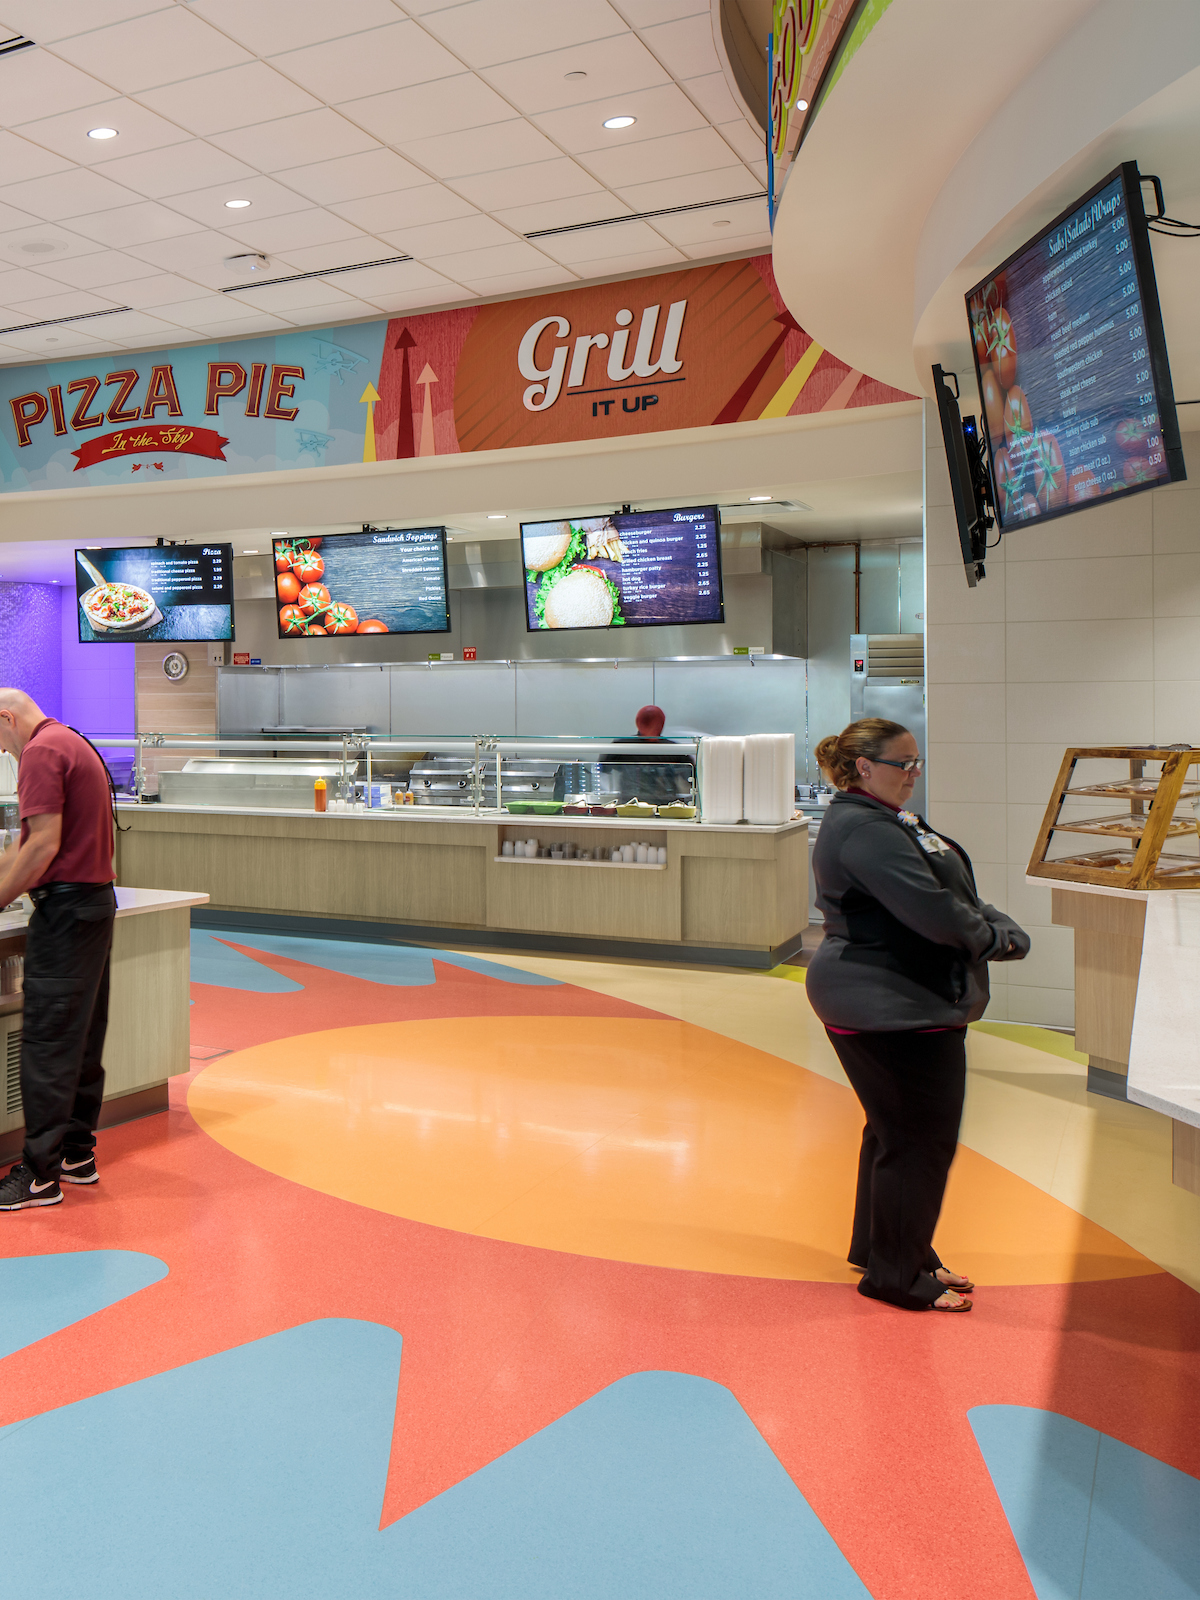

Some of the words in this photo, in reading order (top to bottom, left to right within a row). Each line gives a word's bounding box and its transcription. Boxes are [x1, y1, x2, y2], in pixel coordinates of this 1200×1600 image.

[1064, 247, 1082, 269] smoked
[1082, 235, 1098, 256] turkey
[1111, 215, 1125, 234] 5.00
[1044, 284, 1061, 304] chicken
[1060, 276, 1073, 293] salad
[1115, 236, 1128, 256] 5.00
[1118, 258, 1132, 277] 5.00
[1050, 327, 1061, 342] roast
[1061, 320, 1072, 335] beef
[1121, 280, 1135, 298] 5.00
[1053, 343, 1069, 362] roasted
[1069, 338, 1078, 352] red
[1077, 329, 1094, 348] pepper
[1125, 302, 1139, 320] 5.00
[518, 299, 688, 412] Grill
[1084, 347, 1102, 365] chicken
[1128, 324, 1142, 342] 5.00
[1070, 381, 1080, 393] and
[1080, 373, 1096, 389] cheese
[1132, 346, 1146, 363] 5.00
[9, 364, 183, 447] PIZZA
[203, 362, 305, 421] PIE
[592, 400, 615, 417] IT
[622, 395, 659, 413] UP
[1062, 404, 1077, 420] turkey
[1135, 368, 1149, 385] 5.00
[1065, 424, 1080, 438] turkey
[1079, 419, 1090, 432] club
[1089, 415, 1098, 428] sub
[1138, 390, 1152, 406] 5.00
[101, 433, 127, 454] In
[129, 432, 159, 447] the
[159, 427, 195, 449] Sky
[1068, 444, 1080, 457] asian
[1080, 437, 1097, 452] chicken
[1097, 433, 1106, 446] sub
[1142, 412, 1156, 428] 5.00
[1071, 464, 1083, 477] extra
[1083, 459, 1095, 473] meat
[1146, 434, 1159, 449] 1.00
[1074, 479, 1086, 493] extra
[1085, 473, 1102, 489] cheese
[1148, 452, 1162, 466] 0.50
[372, 534, 404, 543] Sandwich
[406, 533, 438, 542] Toppings
[673, 513, 705, 522] Burgers
[202, 547, 222, 555] Pizza
